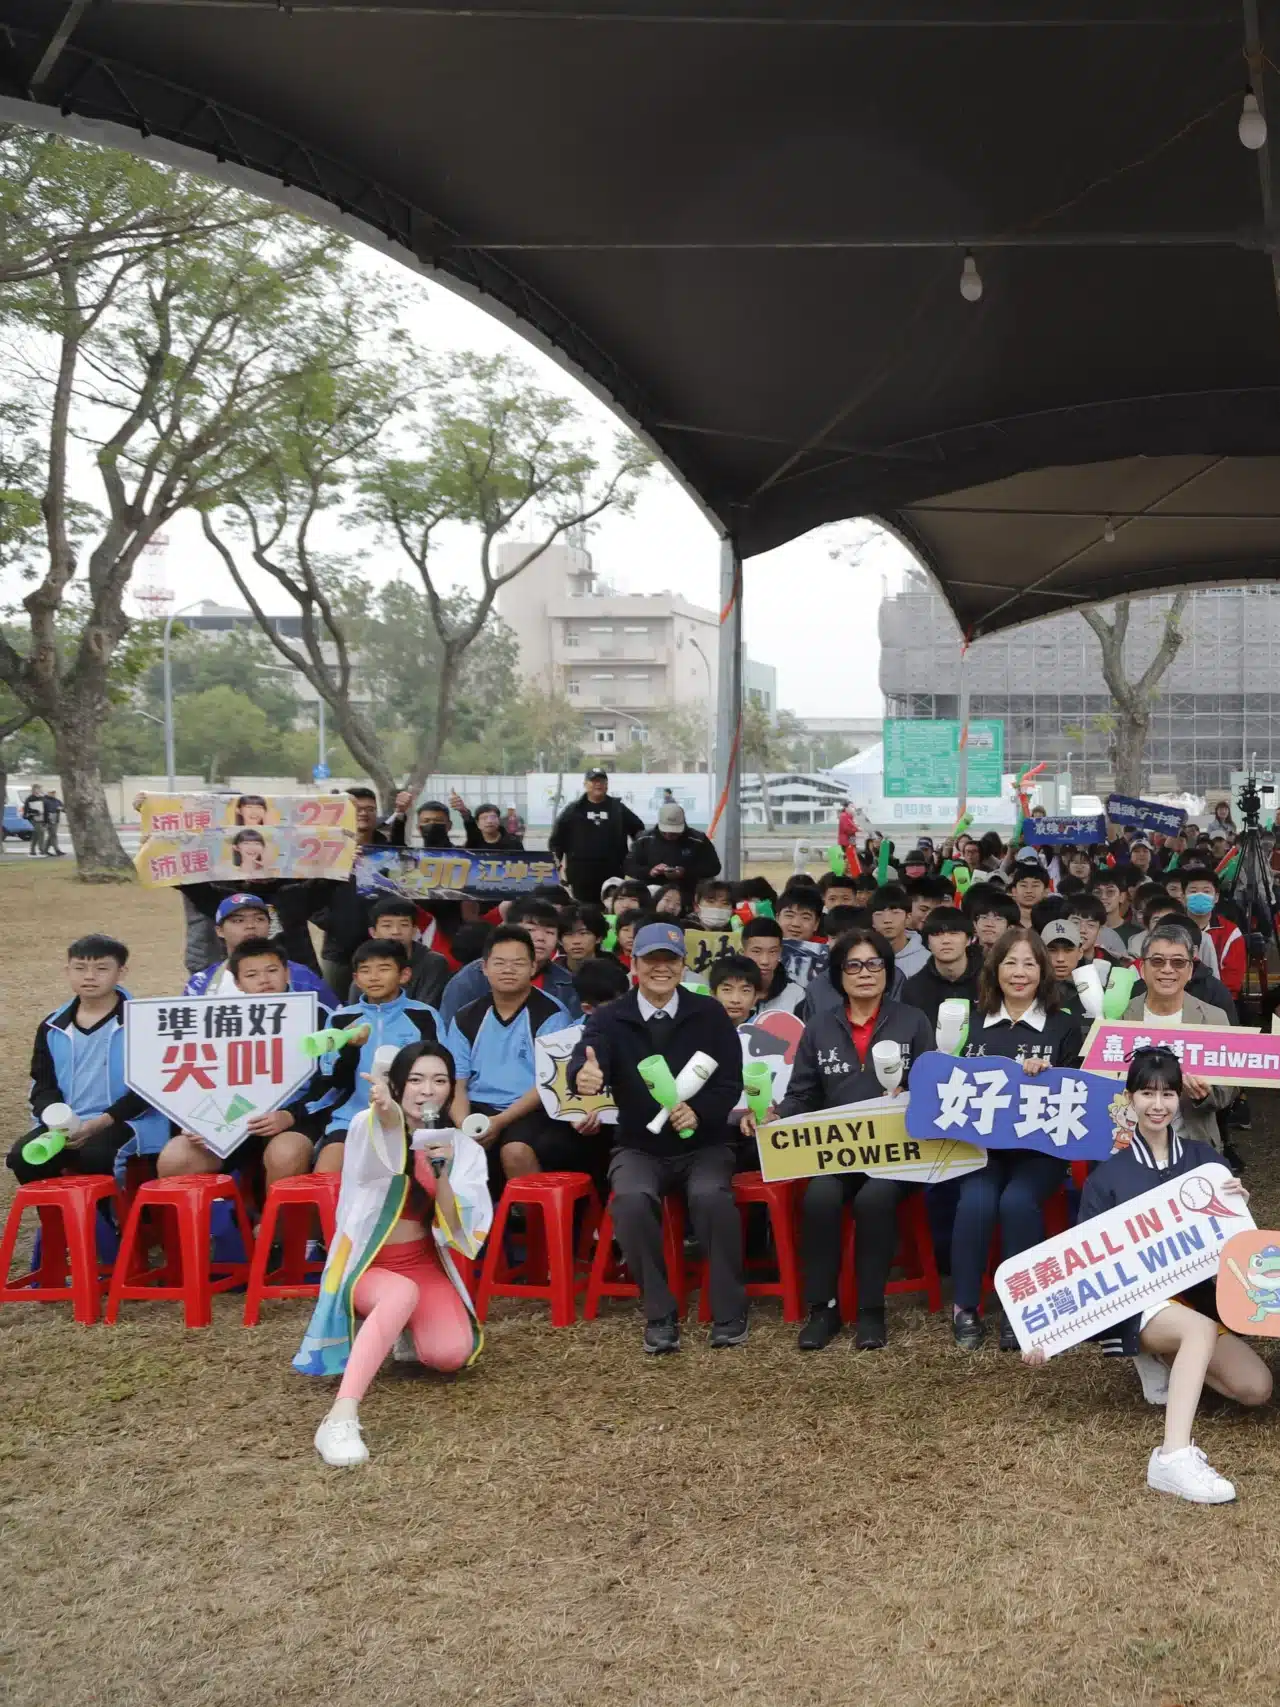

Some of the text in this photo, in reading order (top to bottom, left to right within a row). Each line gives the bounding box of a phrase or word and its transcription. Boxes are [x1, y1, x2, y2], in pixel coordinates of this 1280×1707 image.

[300, 802, 345, 825] 27
[300, 838, 345, 867] 27
[478, 860, 555, 883] 江坤宇
[158, 1003, 287, 1040] 準備好
[161, 1038, 284, 1092] 尖叫
[933, 1066, 1089, 1146] 好球
[771, 1121, 876, 1150] CHIAYI
[817, 1142, 921, 1169] POWER
